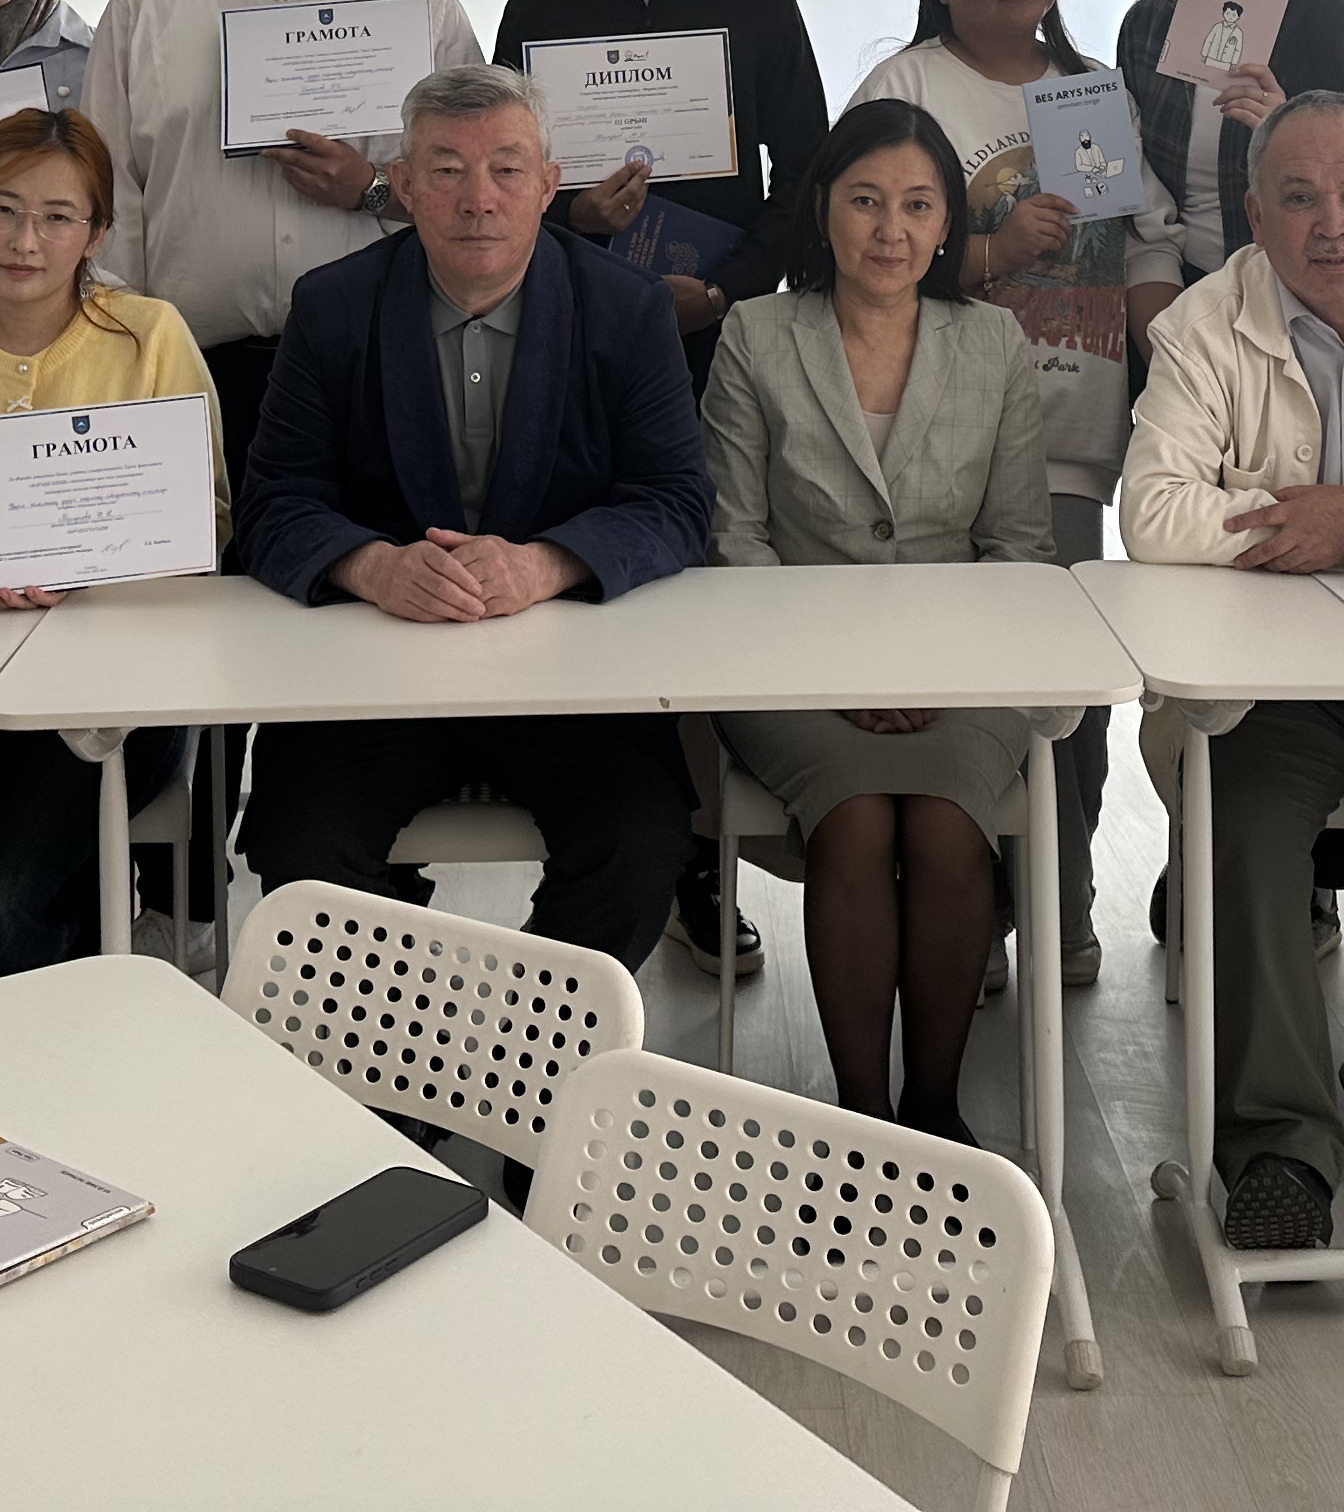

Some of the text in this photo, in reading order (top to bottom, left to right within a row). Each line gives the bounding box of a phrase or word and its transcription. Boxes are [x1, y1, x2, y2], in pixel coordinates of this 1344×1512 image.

[285, 25, 372, 44] ГРАМОТА
[585, 66, 673, 88] ДИПЛОМ
[1035, 82, 1118, 104] BES ARYS NOTES
[963, 131, 1031, 177] ILDLAND
[1042, 356, 1080, 373] Park
[32, 434, 138, 459] ГРАМОТА
